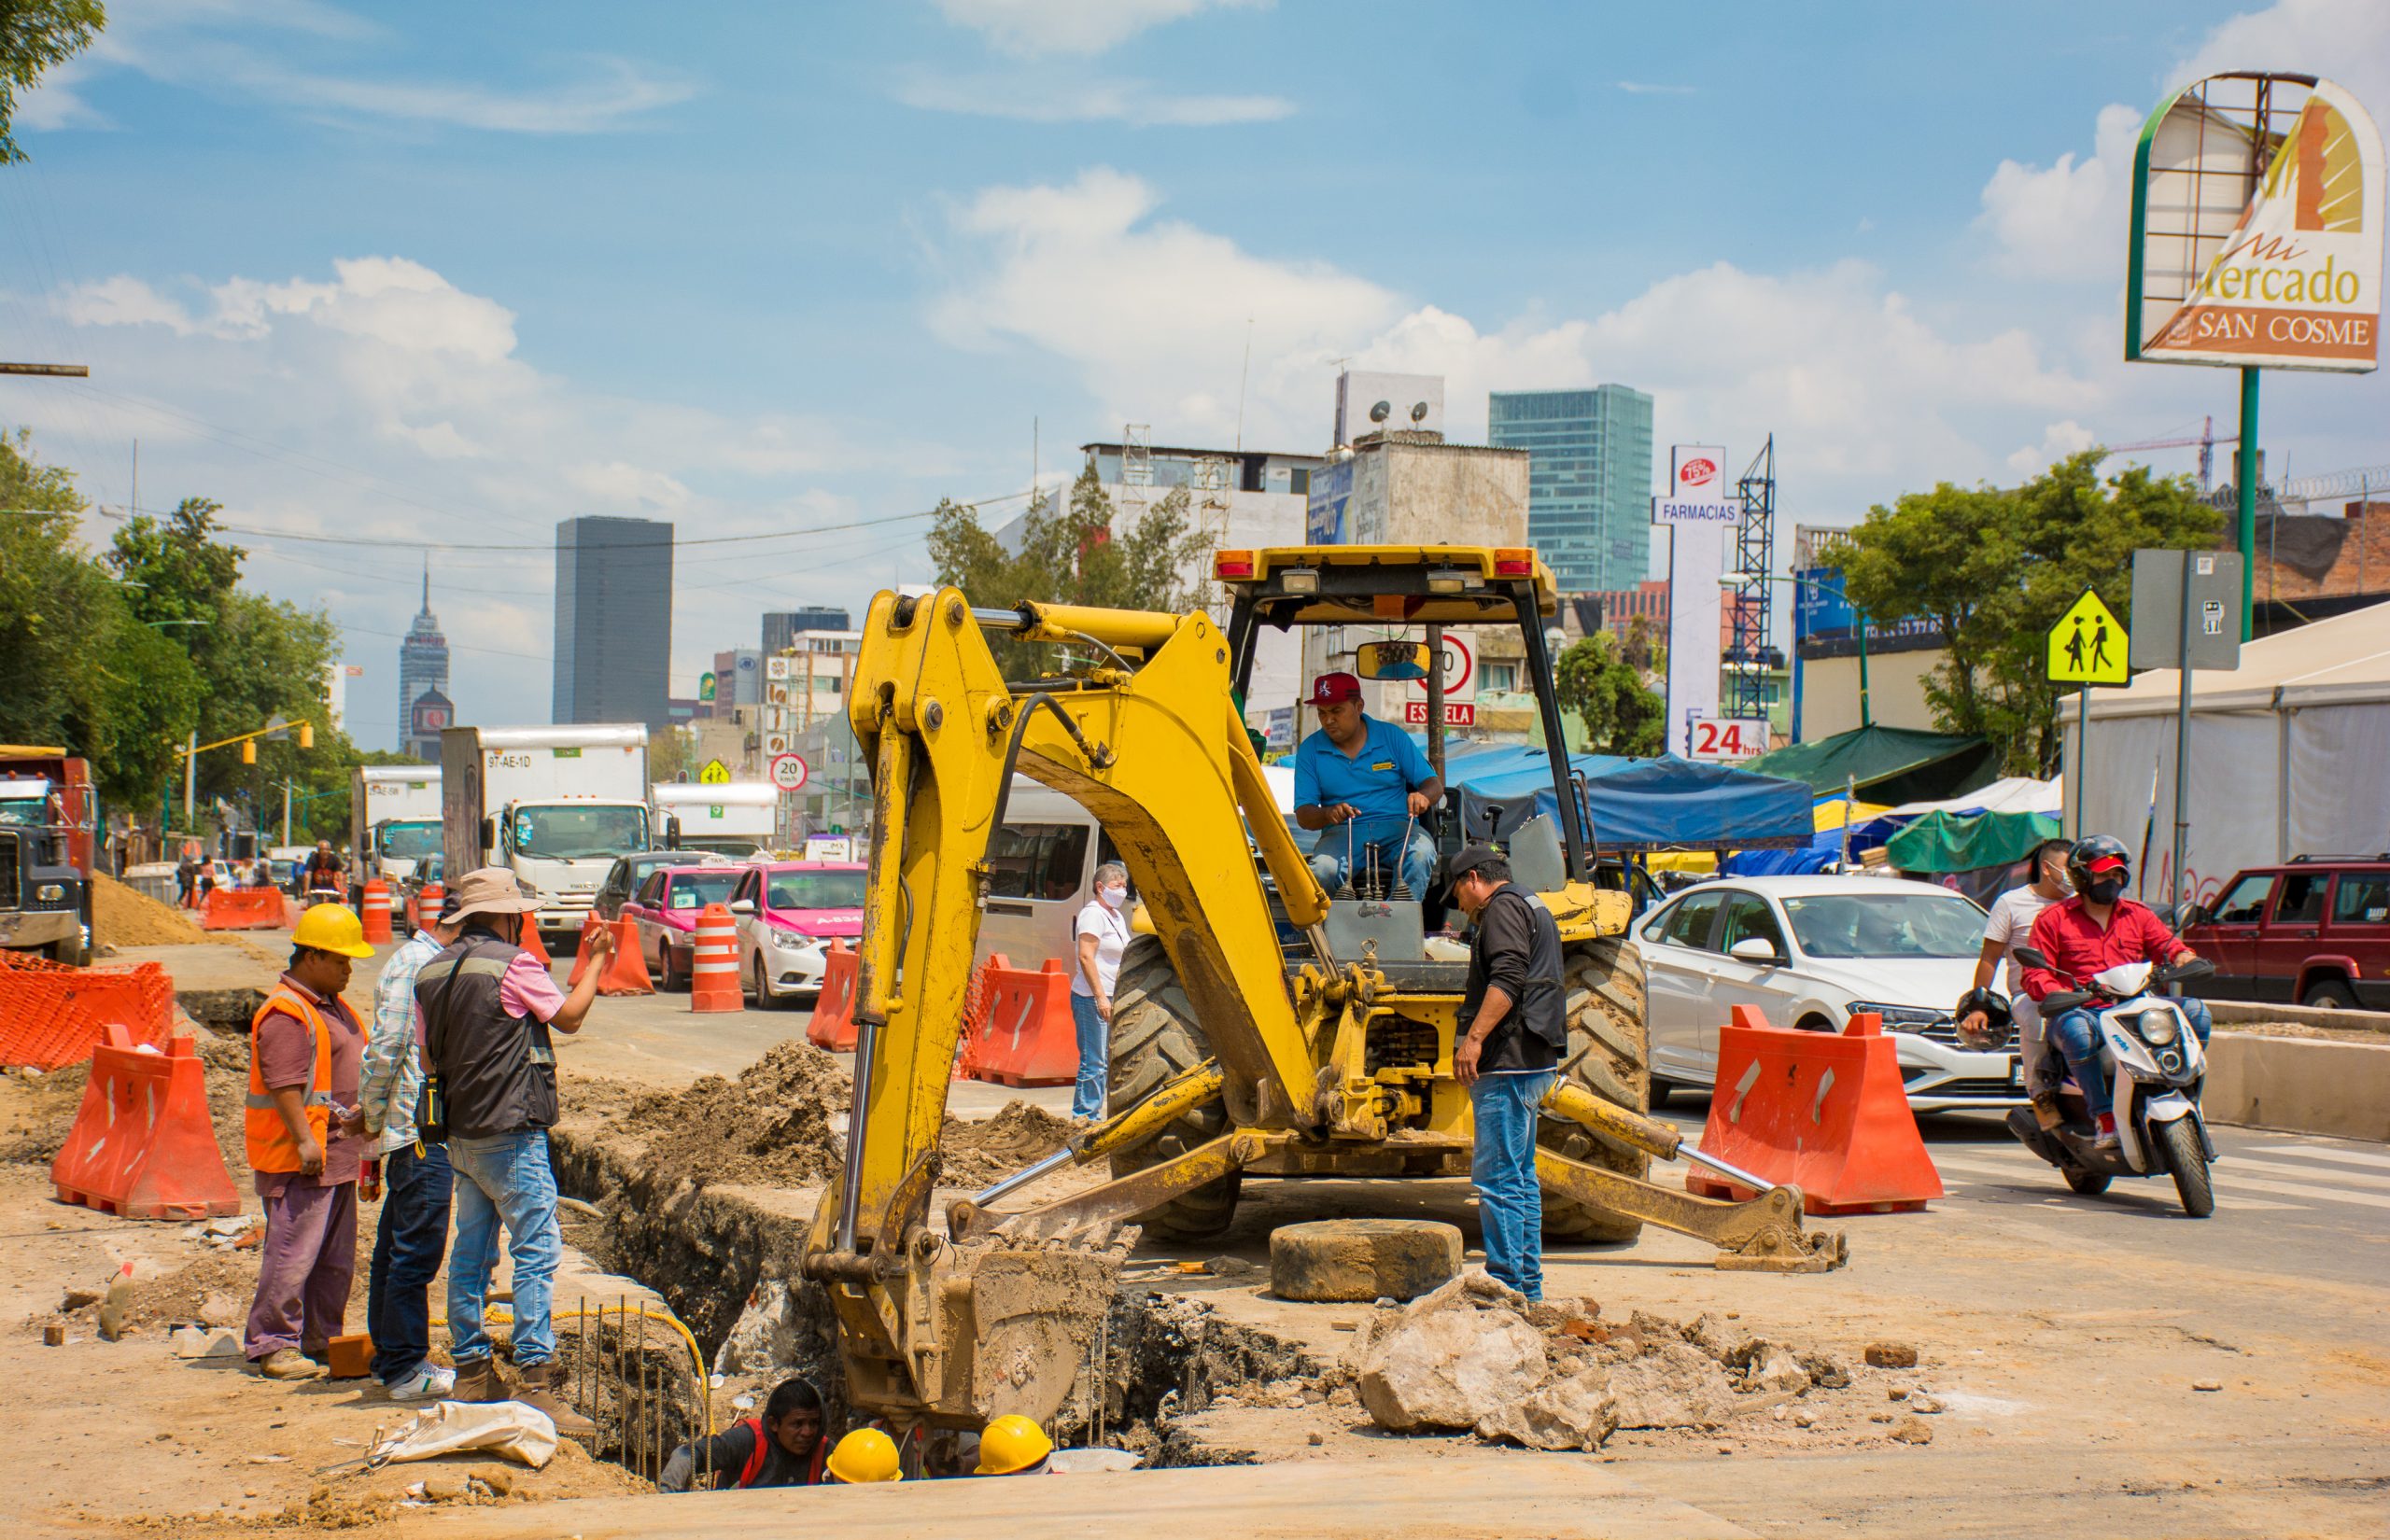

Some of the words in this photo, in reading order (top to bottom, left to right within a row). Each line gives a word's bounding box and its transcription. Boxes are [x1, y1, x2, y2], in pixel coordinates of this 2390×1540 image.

[2223, 231, 2309, 261] Mi
[2198, 312, 2257, 339] SAN
[2268, 315, 2369, 346] COSME
[1685, 461, 1710, 479] 75%
[1664, 504, 1736, 521] FARMACIAS
[1410, 704, 1469, 723] ESELA
[1696, 722, 1742, 755] 24
[1743, 744, 1763, 756] hrs
[488, 755, 531, 768] 97-AE-1D
[780, 762, 798, 775] 20
[817, 916, 864, 925] A-834
